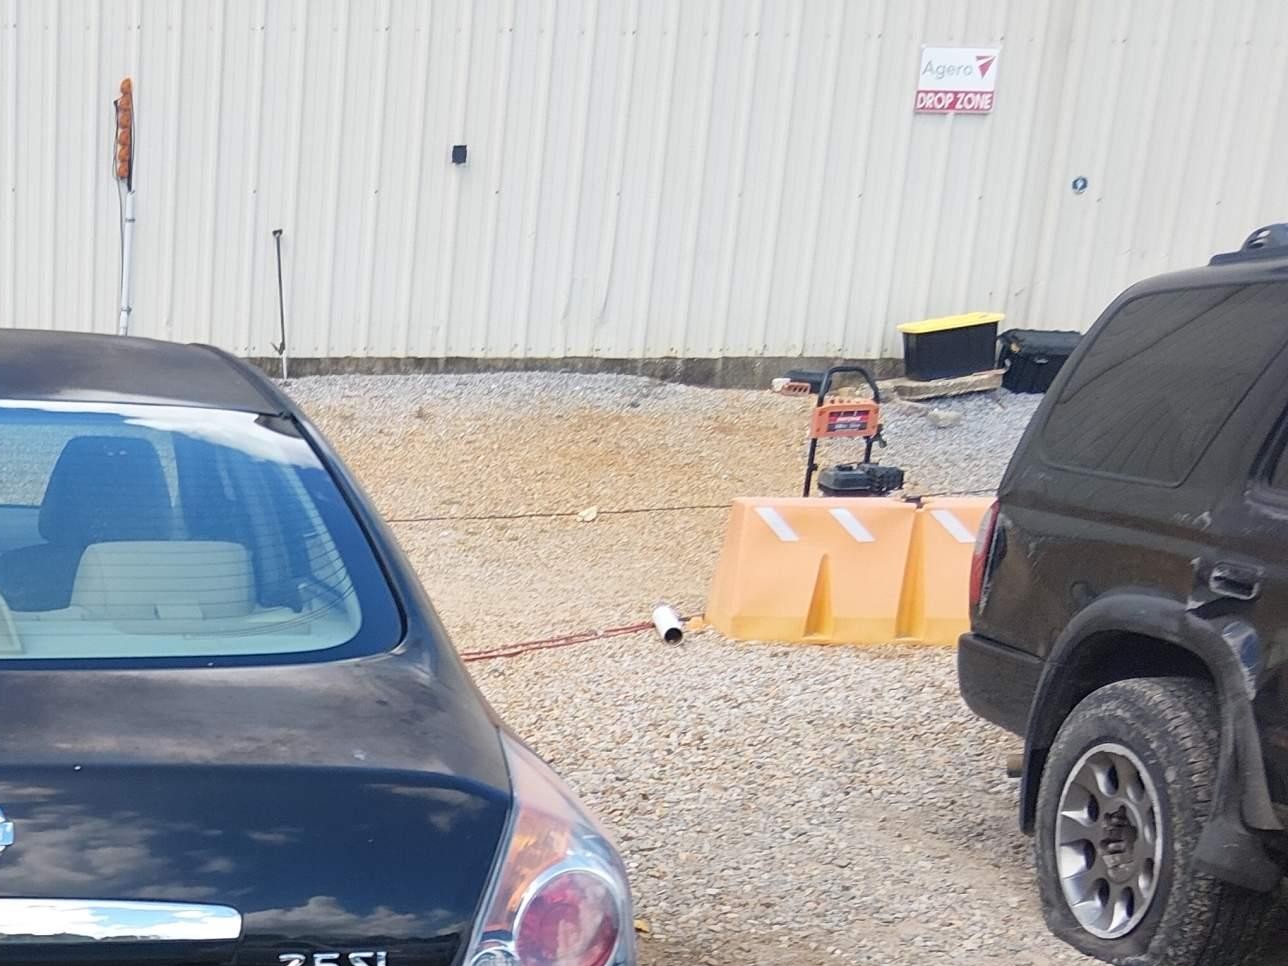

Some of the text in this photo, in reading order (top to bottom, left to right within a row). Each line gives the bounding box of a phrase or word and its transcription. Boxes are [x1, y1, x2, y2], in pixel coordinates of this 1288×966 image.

[922, 60, 974, 80] Agero
[916, 92, 993, 110] DROP ZONE
